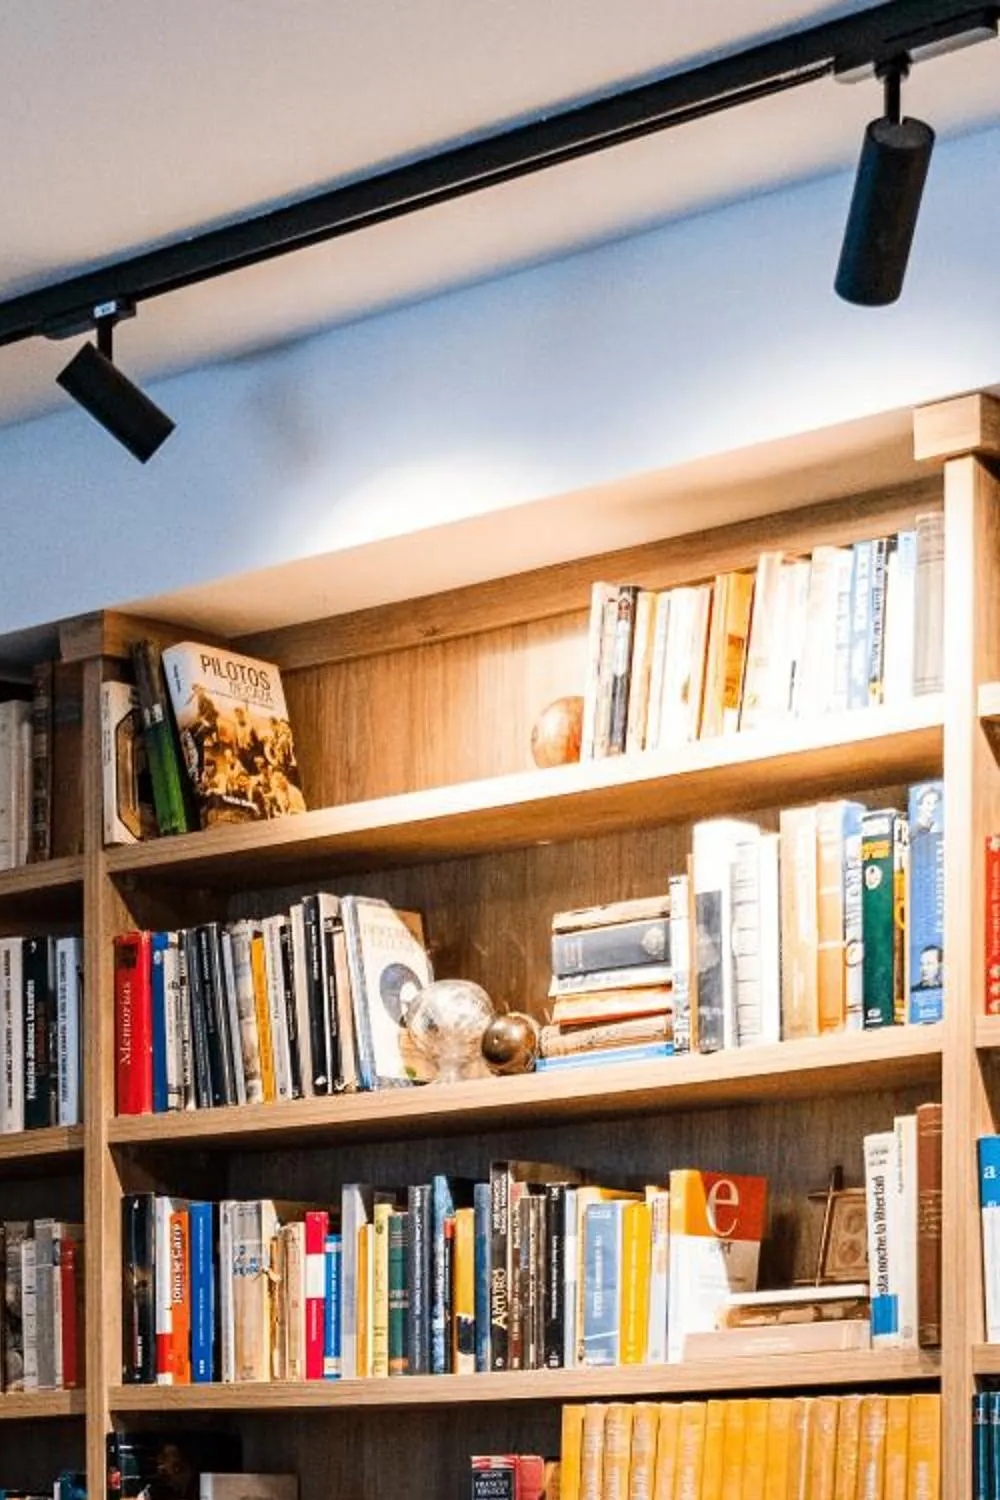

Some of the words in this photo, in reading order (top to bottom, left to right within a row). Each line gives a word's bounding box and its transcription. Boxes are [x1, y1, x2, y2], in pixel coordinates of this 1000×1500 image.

[200, 654, 271, 690] PILOTOS
[120, 982, 132, 1065] Memorias
[706, 1179, 740, 1237] e
[871, 1175, 885, 1222] libertad
[491, 1267, 508, 1329] ARTURO
[876, 1274, 889, 1294] sta
